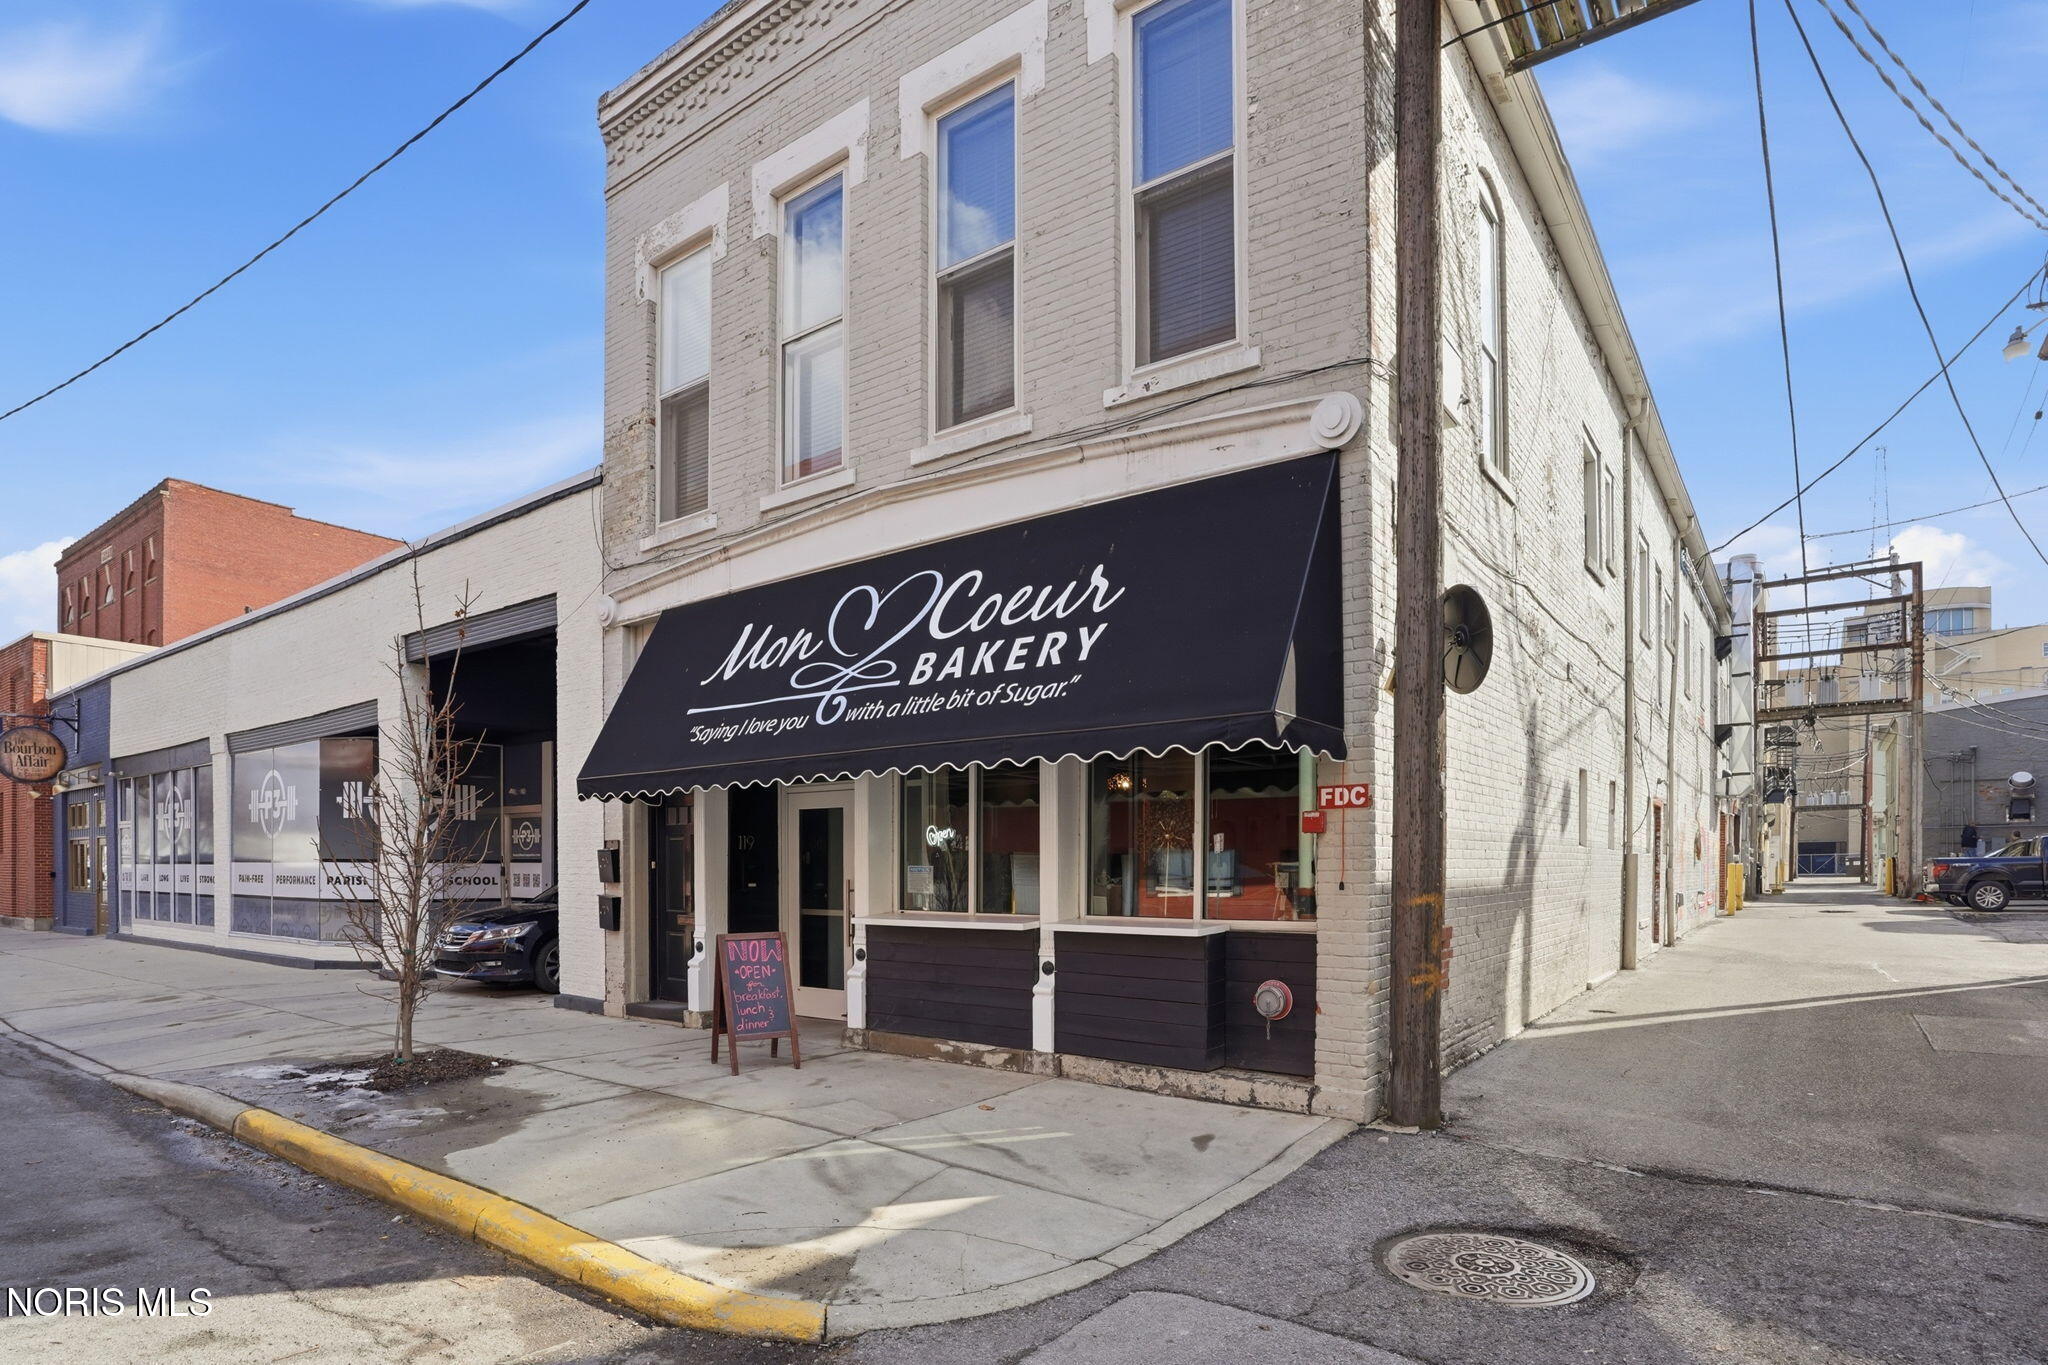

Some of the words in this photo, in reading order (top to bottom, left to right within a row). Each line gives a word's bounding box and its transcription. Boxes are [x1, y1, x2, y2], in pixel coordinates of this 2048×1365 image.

[700, 623, 824, 686] Mon
[928, 563, 1126, 640] Coeur
[908, 622, 1109, 686] BAKERY
[690, 722, 740, 745] "Saying
[738, 719, 749, 736] I
[745, 717, 777, 735] love
[773, 715, 810, 736] you
[845, 700, 884, 722] with
[886, 703, 901, 718] a
[901, 693, 945, 717] little
[946, 688, 975, 710] bit
[976, 683, 1006, 706] of
[4, 741, 56, 755] Bourbon
[15, 755, 49, 767] Affair
[1320, 786, 1366, 806] FDC
[264, 789, 281, 820] P3
[738, 835, 755, 850] 119
[926, 825, 955, 847] Open
[238, 874, 264, 884] PAIN-FREE
[276, 875, 316, 886] PERFORMANCE
[447, 876, 499, 886] SCHOOL
[727, 940, 782, 962] NOW
[740, 965, 771, 979] OPEN
[746, 980, 764, 992] for
[736, 1002, 765, 1016] lunch
[736, 1018, 770, 1031] dinner
